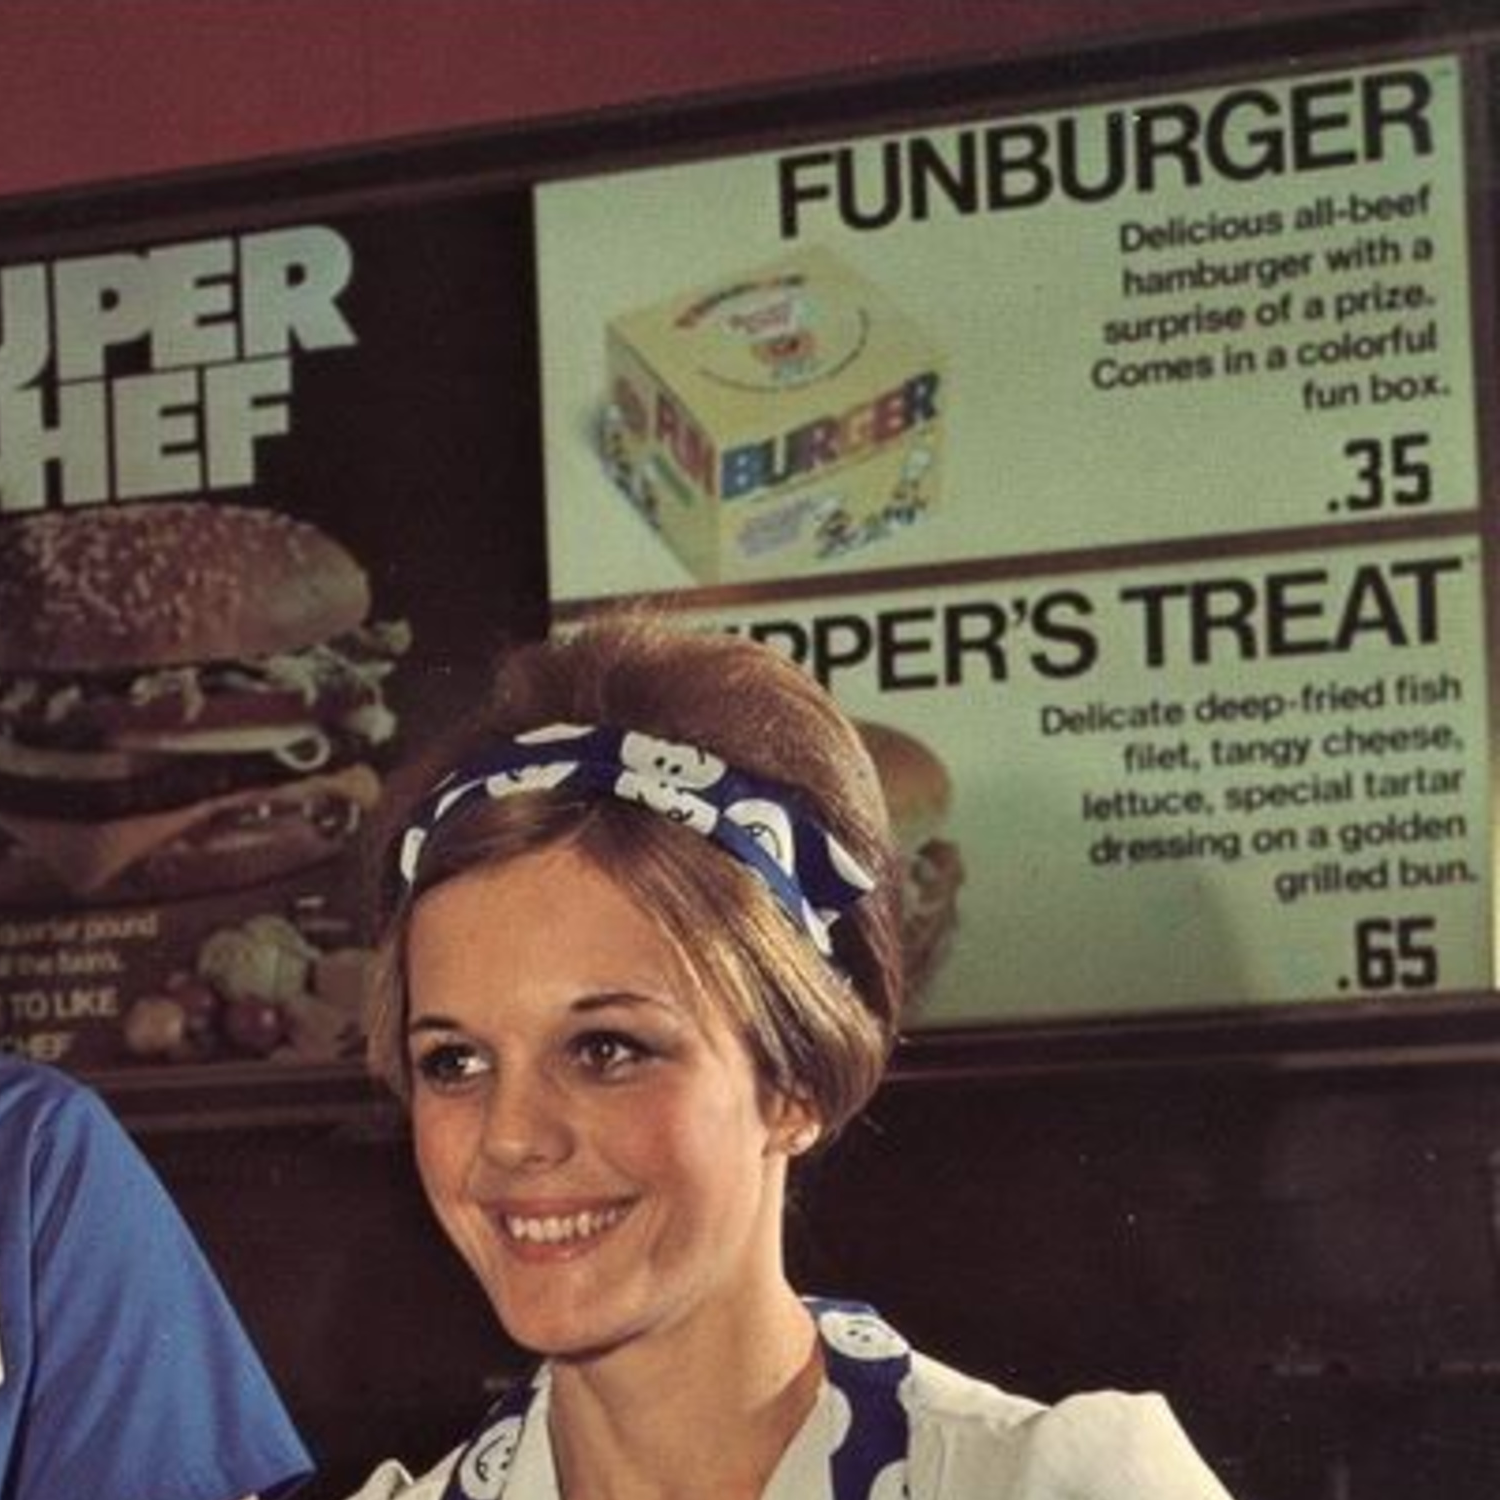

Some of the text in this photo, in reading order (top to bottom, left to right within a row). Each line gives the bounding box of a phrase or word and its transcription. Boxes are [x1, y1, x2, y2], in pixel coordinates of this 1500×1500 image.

[777, 70, 1434, 240] FUNBURGER
[1119, 184, 1432, 252] Delicious all-beef
[1122, 235, 1434, 298] hamburger with a
[1102, 281, 1437, 345] surprise of a prize.
[1091, 321, 1438, 390] Comes in a colorful
[1303, 373, 1452, 411] fun box.
[720, 370, 941, 501] BURGER
[1325, 433, 1433, 514] .35
[724, 556, 1463, 694] PPER'S TREAT
[1041, 673, 1463, 737] Delicate deep-fried fish
[1122, 721, 1466, 776] filet, tangy cheese,
[1081, 765, 1467, 824] lettuce, special tartar
[1089, 811, 1468, 868] dressing on a golden
[1274, 857, 1481, 903] grilled bun.
[1335, 914, 1440, 991] .65
[55, 987, 120, 1018] LIKE
